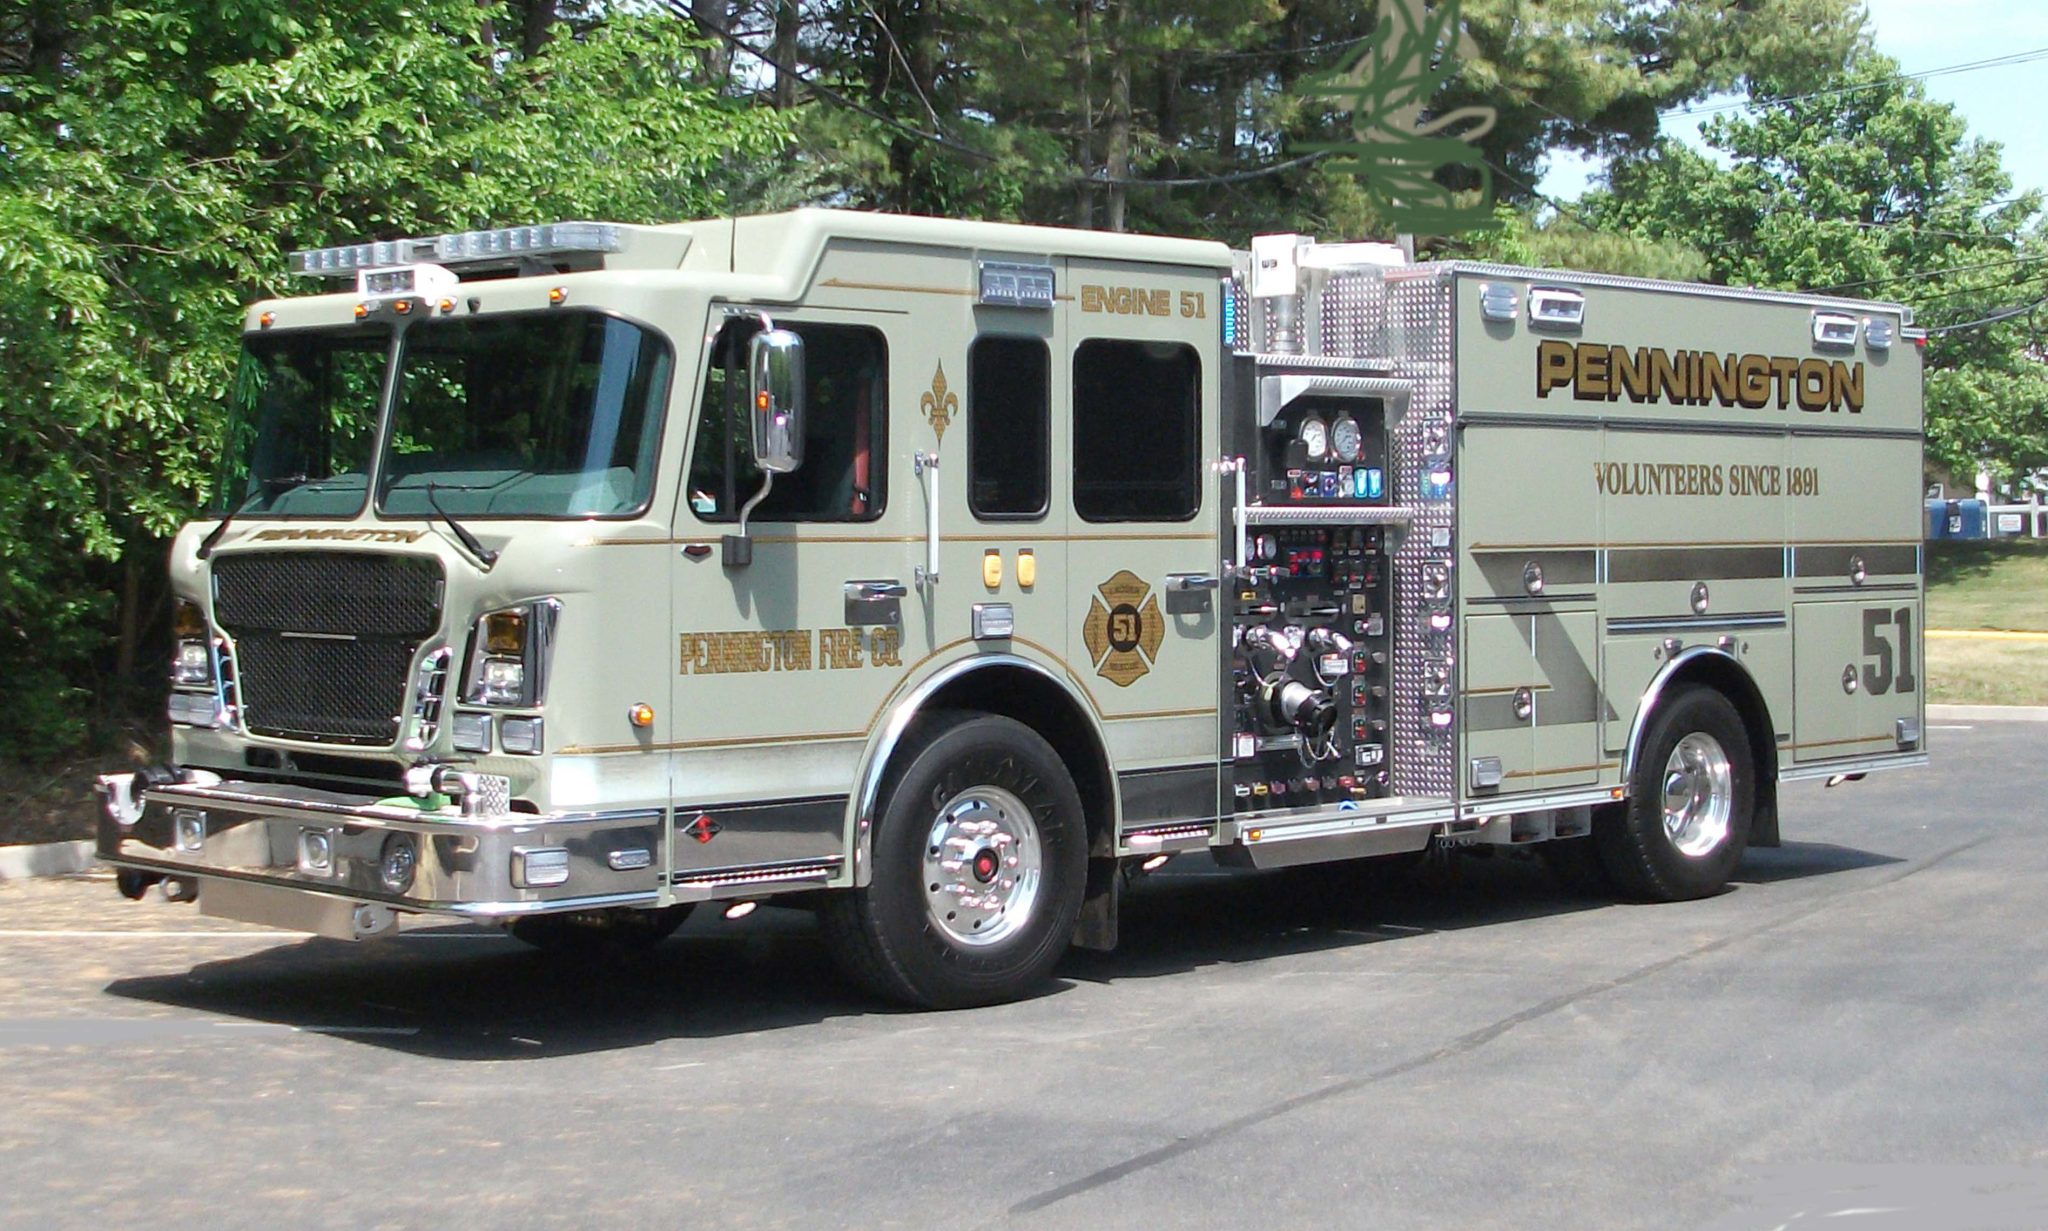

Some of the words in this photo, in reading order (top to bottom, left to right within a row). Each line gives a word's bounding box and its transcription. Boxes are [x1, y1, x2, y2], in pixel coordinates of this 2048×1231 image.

[1081, 284, 1171, 317] ENGINE
[1180, 290, 1206, 319] 51
[1536, 339, 1864, 414] PENNINGTON
[1594, 461, 1724, 496] VOLUNTEERS
[1729, 464, 1781, 497] SINCE
[1786, 466, 1819, 497] 1891
[249, 528, 425, 544] PENNINGTON
[1112, 612, 1138, 642] 51
[679, 629, 812, 675] PENNINGTON
[818, 627, 865, 670] FIRE
[870, 626, 904, 668] CO.
[1862, 606, 1916, 696] 51
